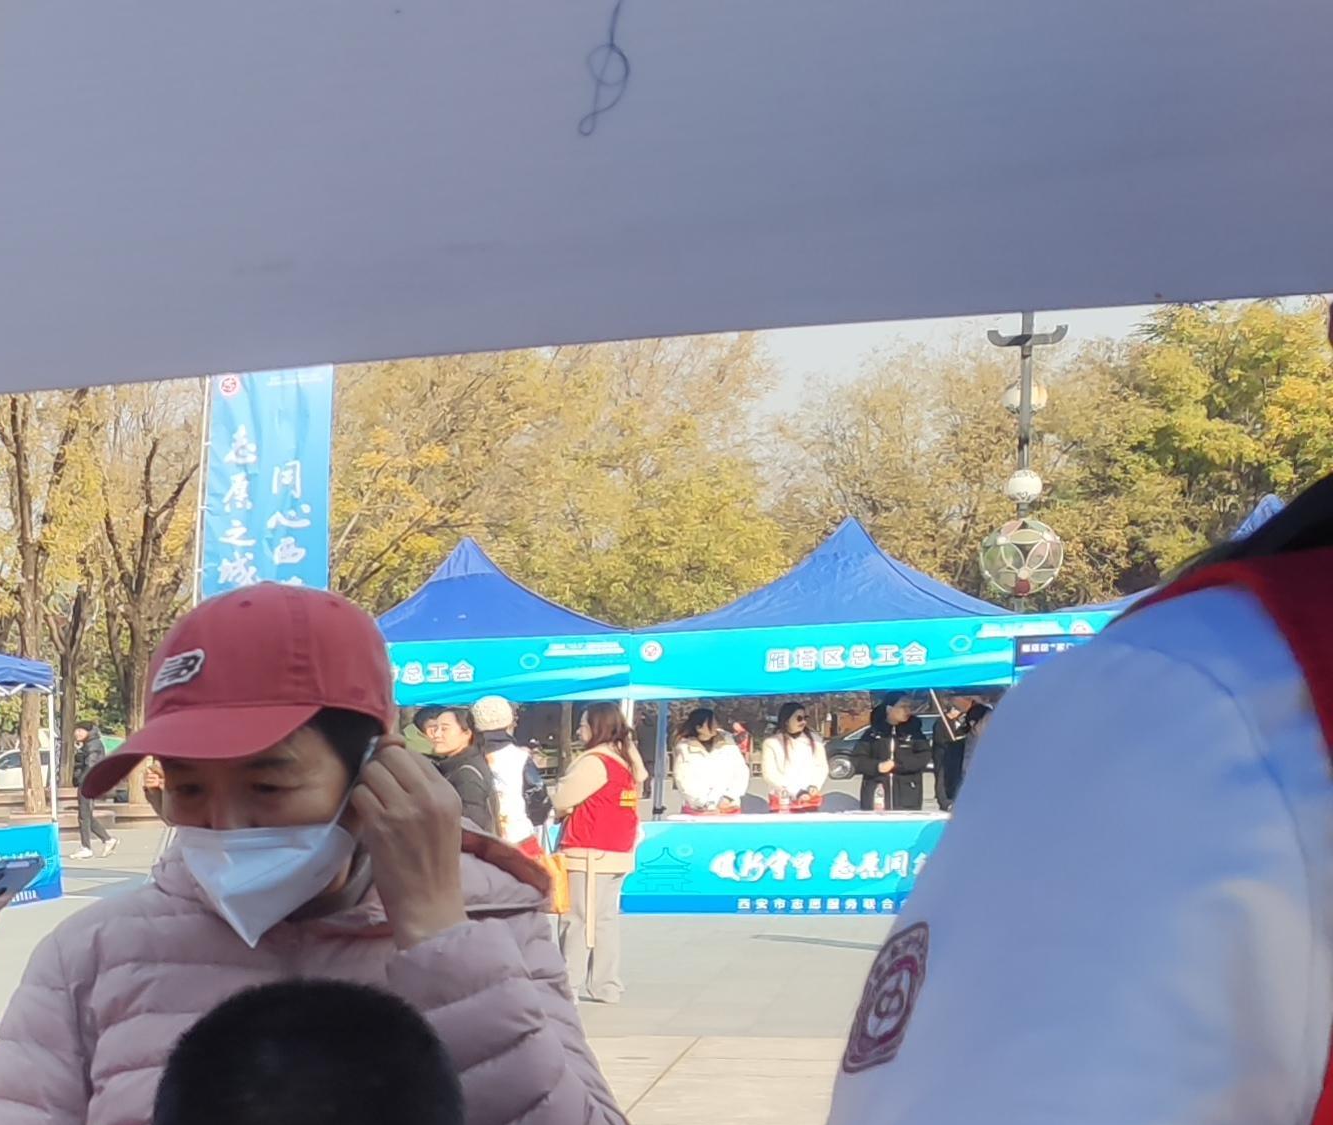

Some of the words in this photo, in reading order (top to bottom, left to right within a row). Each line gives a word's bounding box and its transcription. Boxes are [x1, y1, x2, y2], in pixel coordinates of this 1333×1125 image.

[266, 459, 313, 586] 同心西
[766, 642, 927, 672] 雁塔区总工会
[738, 897, 907, 911] 西安市志愿服务联合
